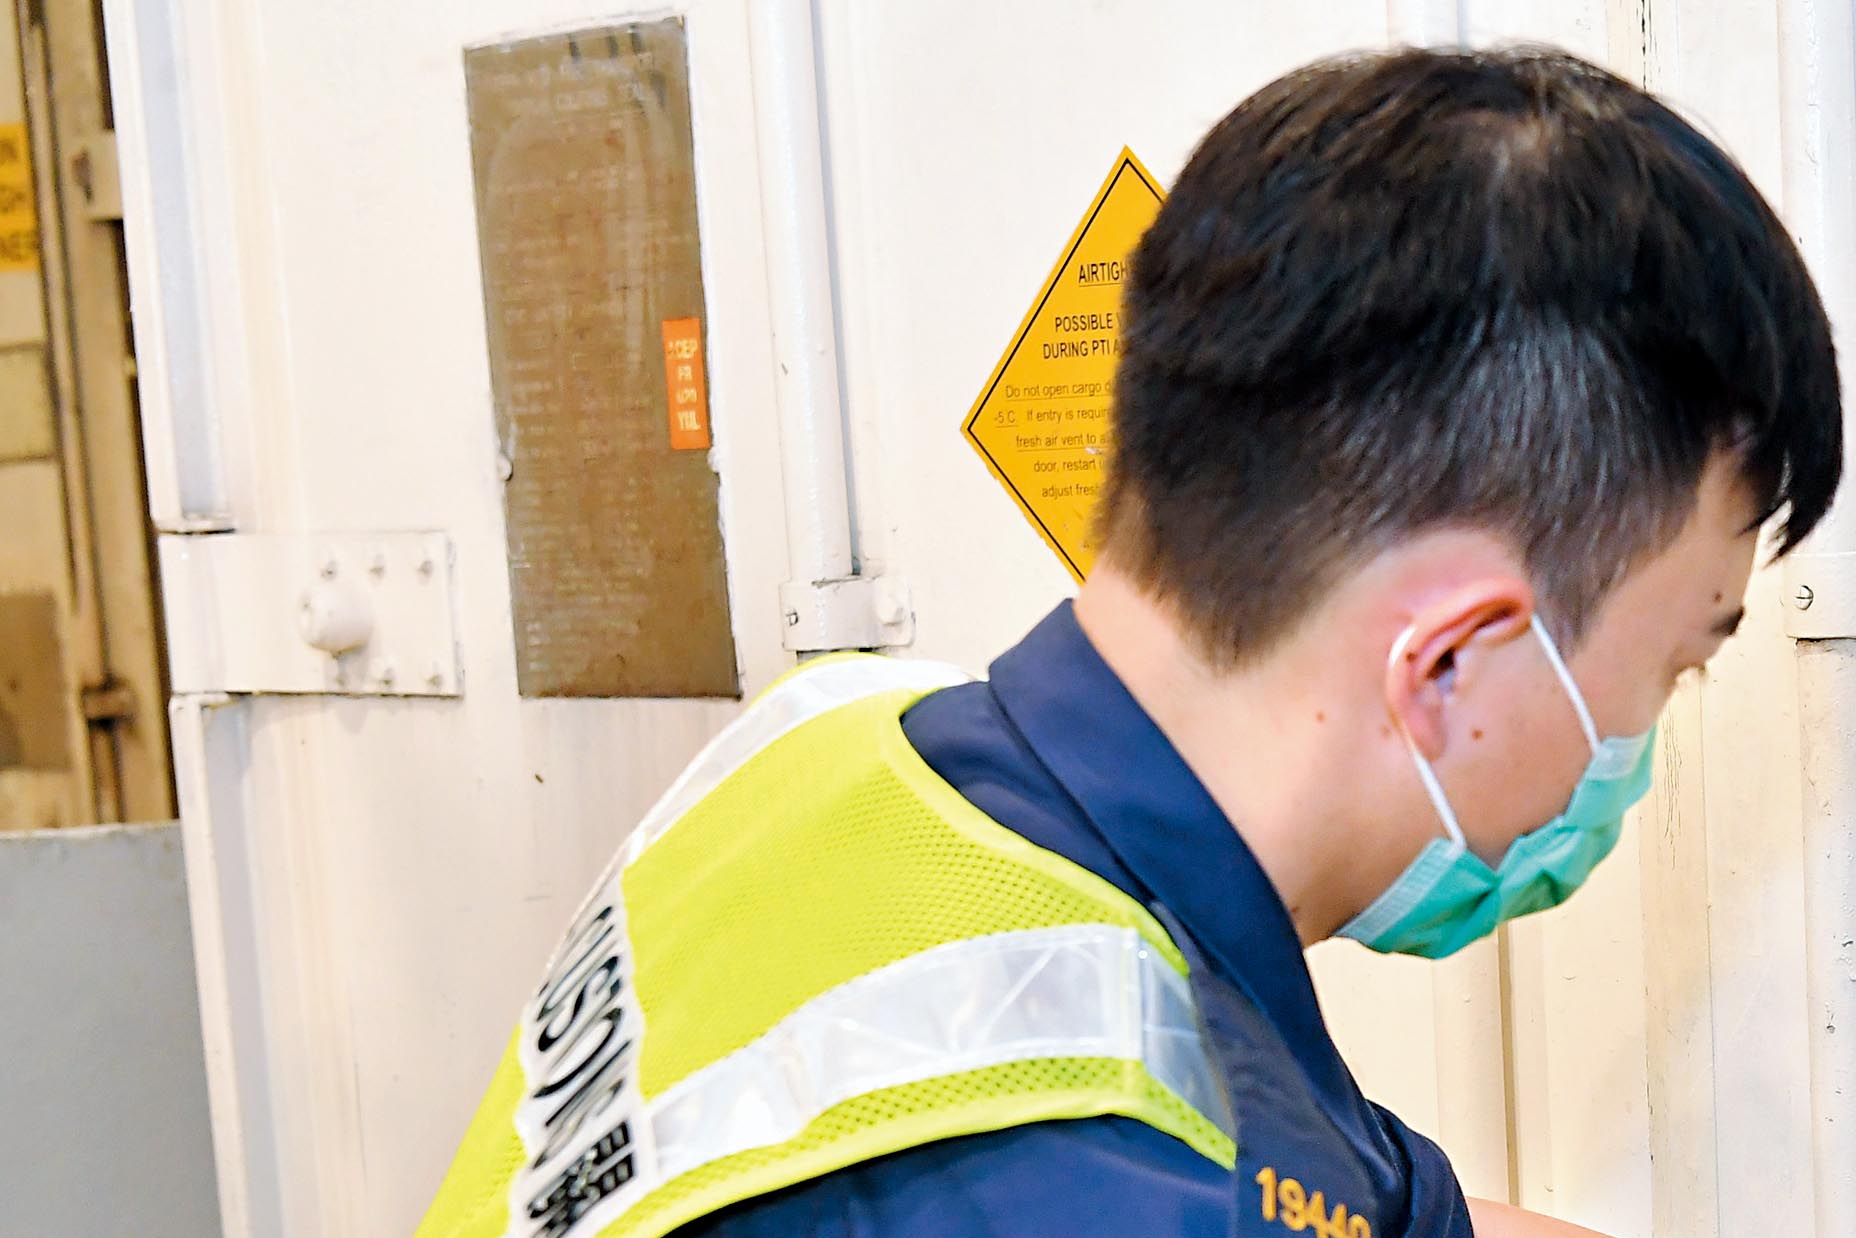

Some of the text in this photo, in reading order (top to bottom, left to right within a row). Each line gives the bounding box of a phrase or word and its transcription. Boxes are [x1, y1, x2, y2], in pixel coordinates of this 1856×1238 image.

[1078, 261, 1129, 283] AIRTIGH
[1055, 313, 1113, 332] POSSIBLE
[1043, 341, 1089, 359] DURING
[1091, 339, 1110, 356] PTI
[1005, 385, 1020, 398] Do
[1023, 385, 1040, 396] not
[1042, 385, 1069, 399] open
[1072, 382, 1102, 397] cargo
[1026, 409, 1034, 421] If
[1036, 410, 1062, 422] entry
[1065, 409, 1074, 420] is
[1077, 408, 1110, 421] requir
[1016, 435, 1042, 448] fresh
[1045, 434, 1058, 447] air
[1061, 433, 1084, 446] vent
[1087, 433, 1097, 444] to
[1062, 459, 1097, 471] restart
[1042, 485, 1074, 500] adjust
